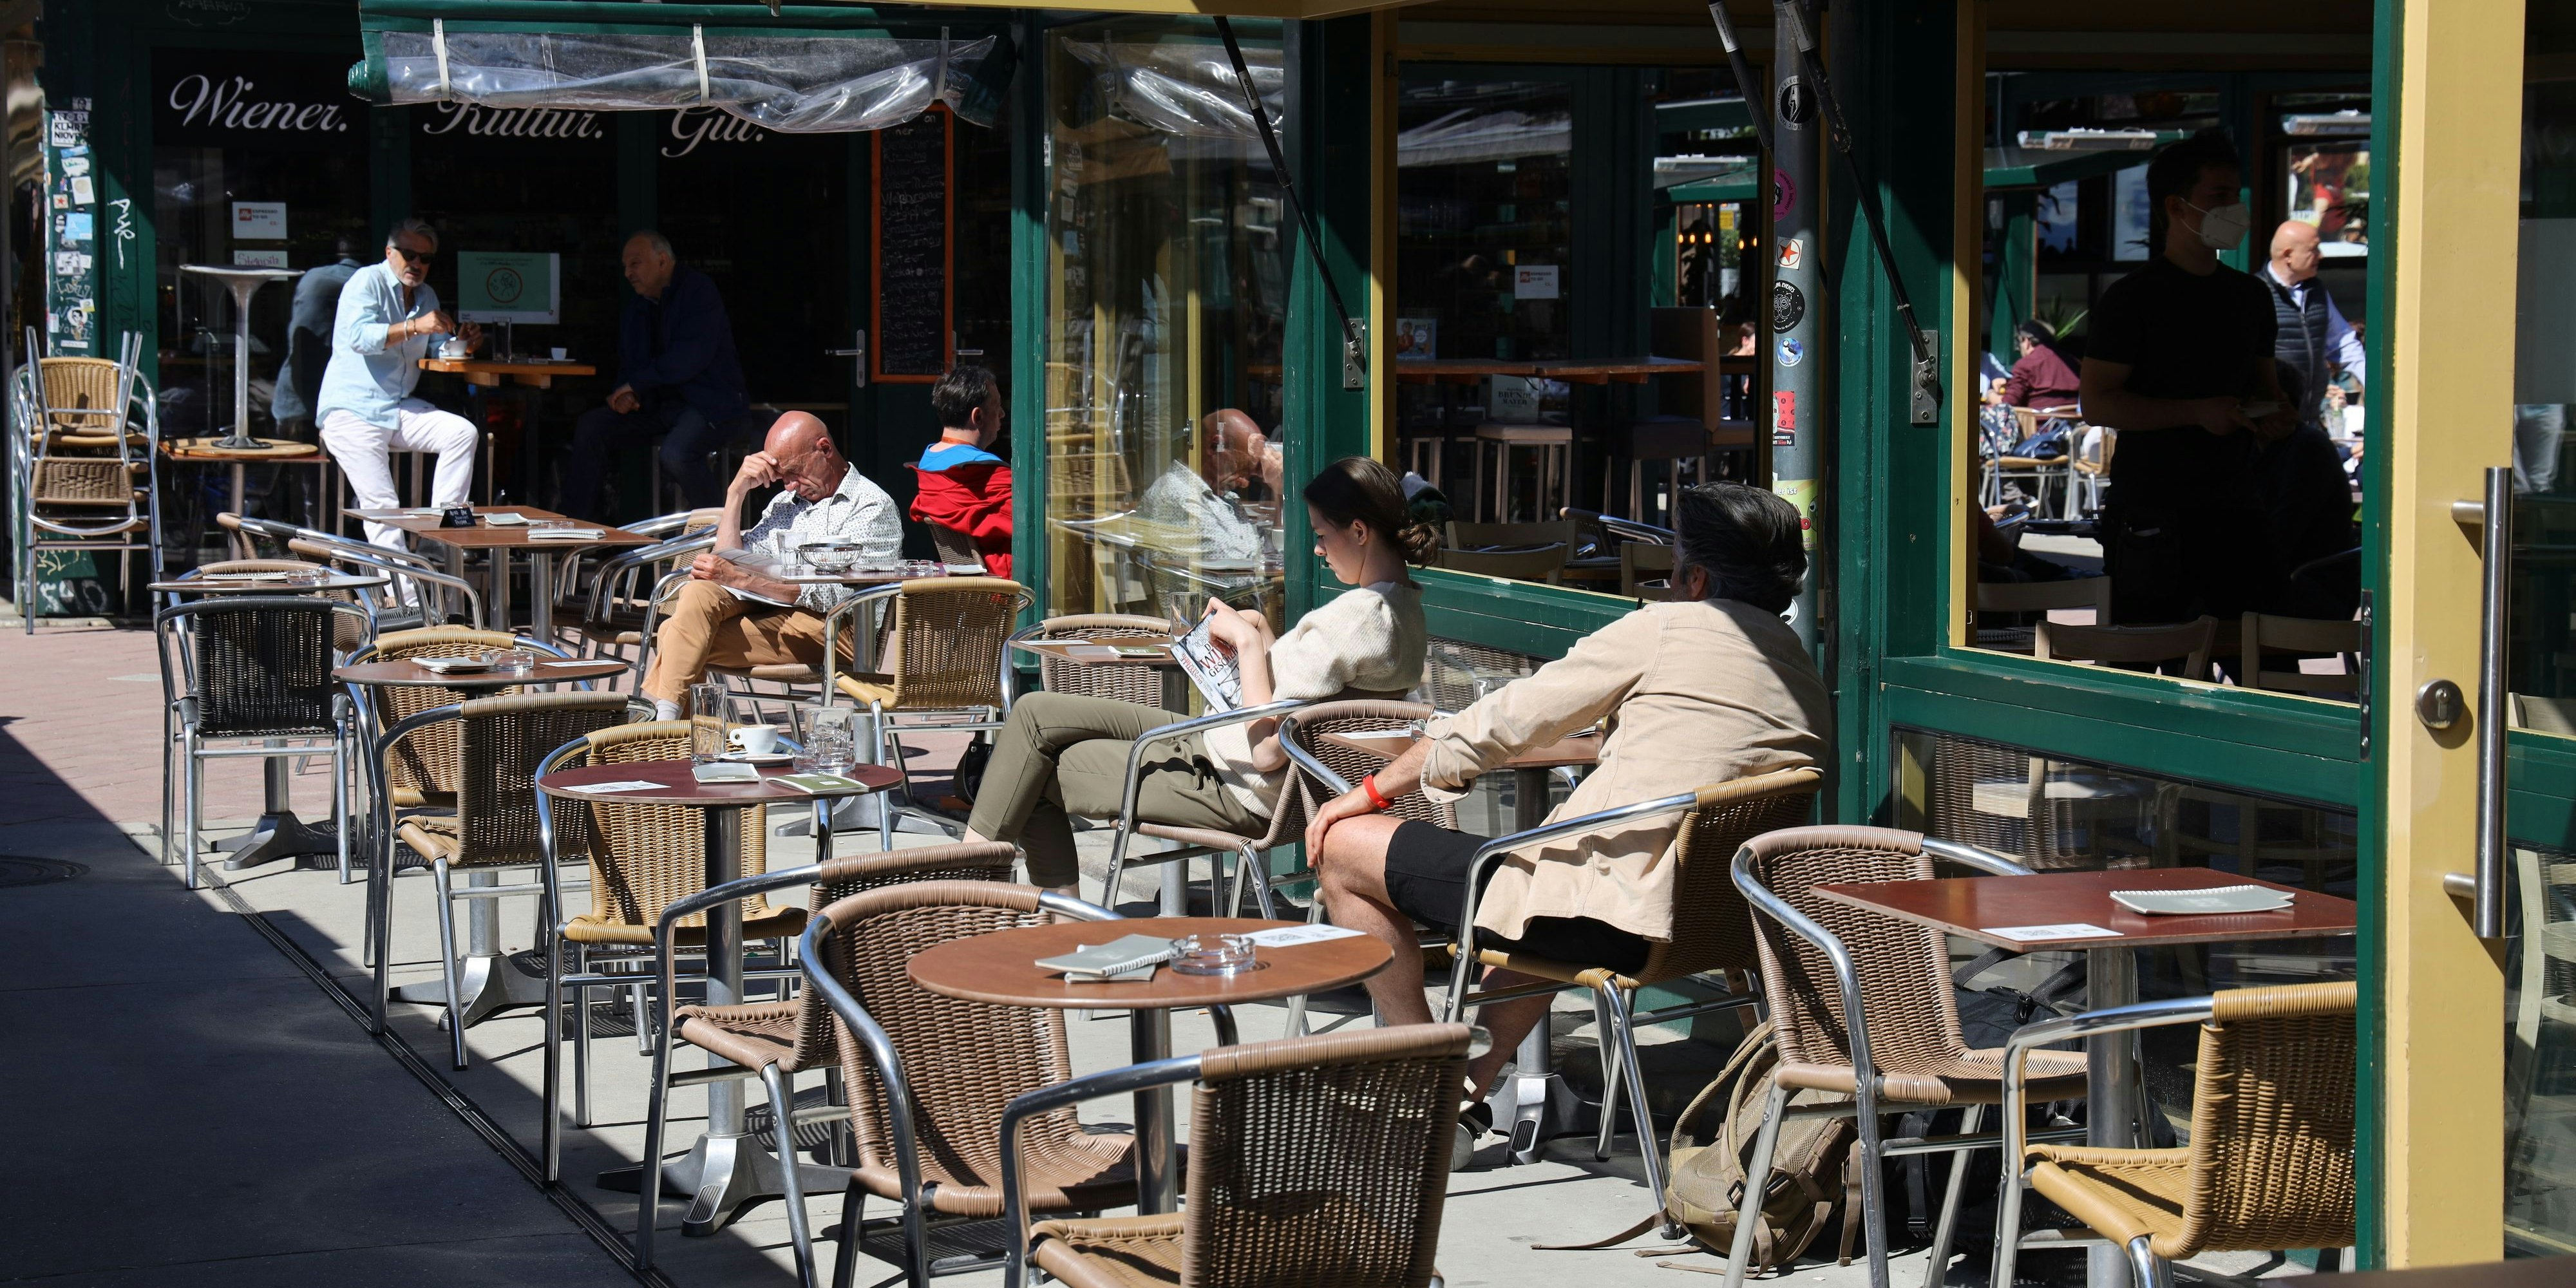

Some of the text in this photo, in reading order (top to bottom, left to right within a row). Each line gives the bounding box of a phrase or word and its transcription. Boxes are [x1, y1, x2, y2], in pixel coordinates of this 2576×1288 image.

[169, 74, 348, 132] Wiener.
[1781, 282, 1795, 293] EVENTS
[1787, 487, 1797, 495] ist
